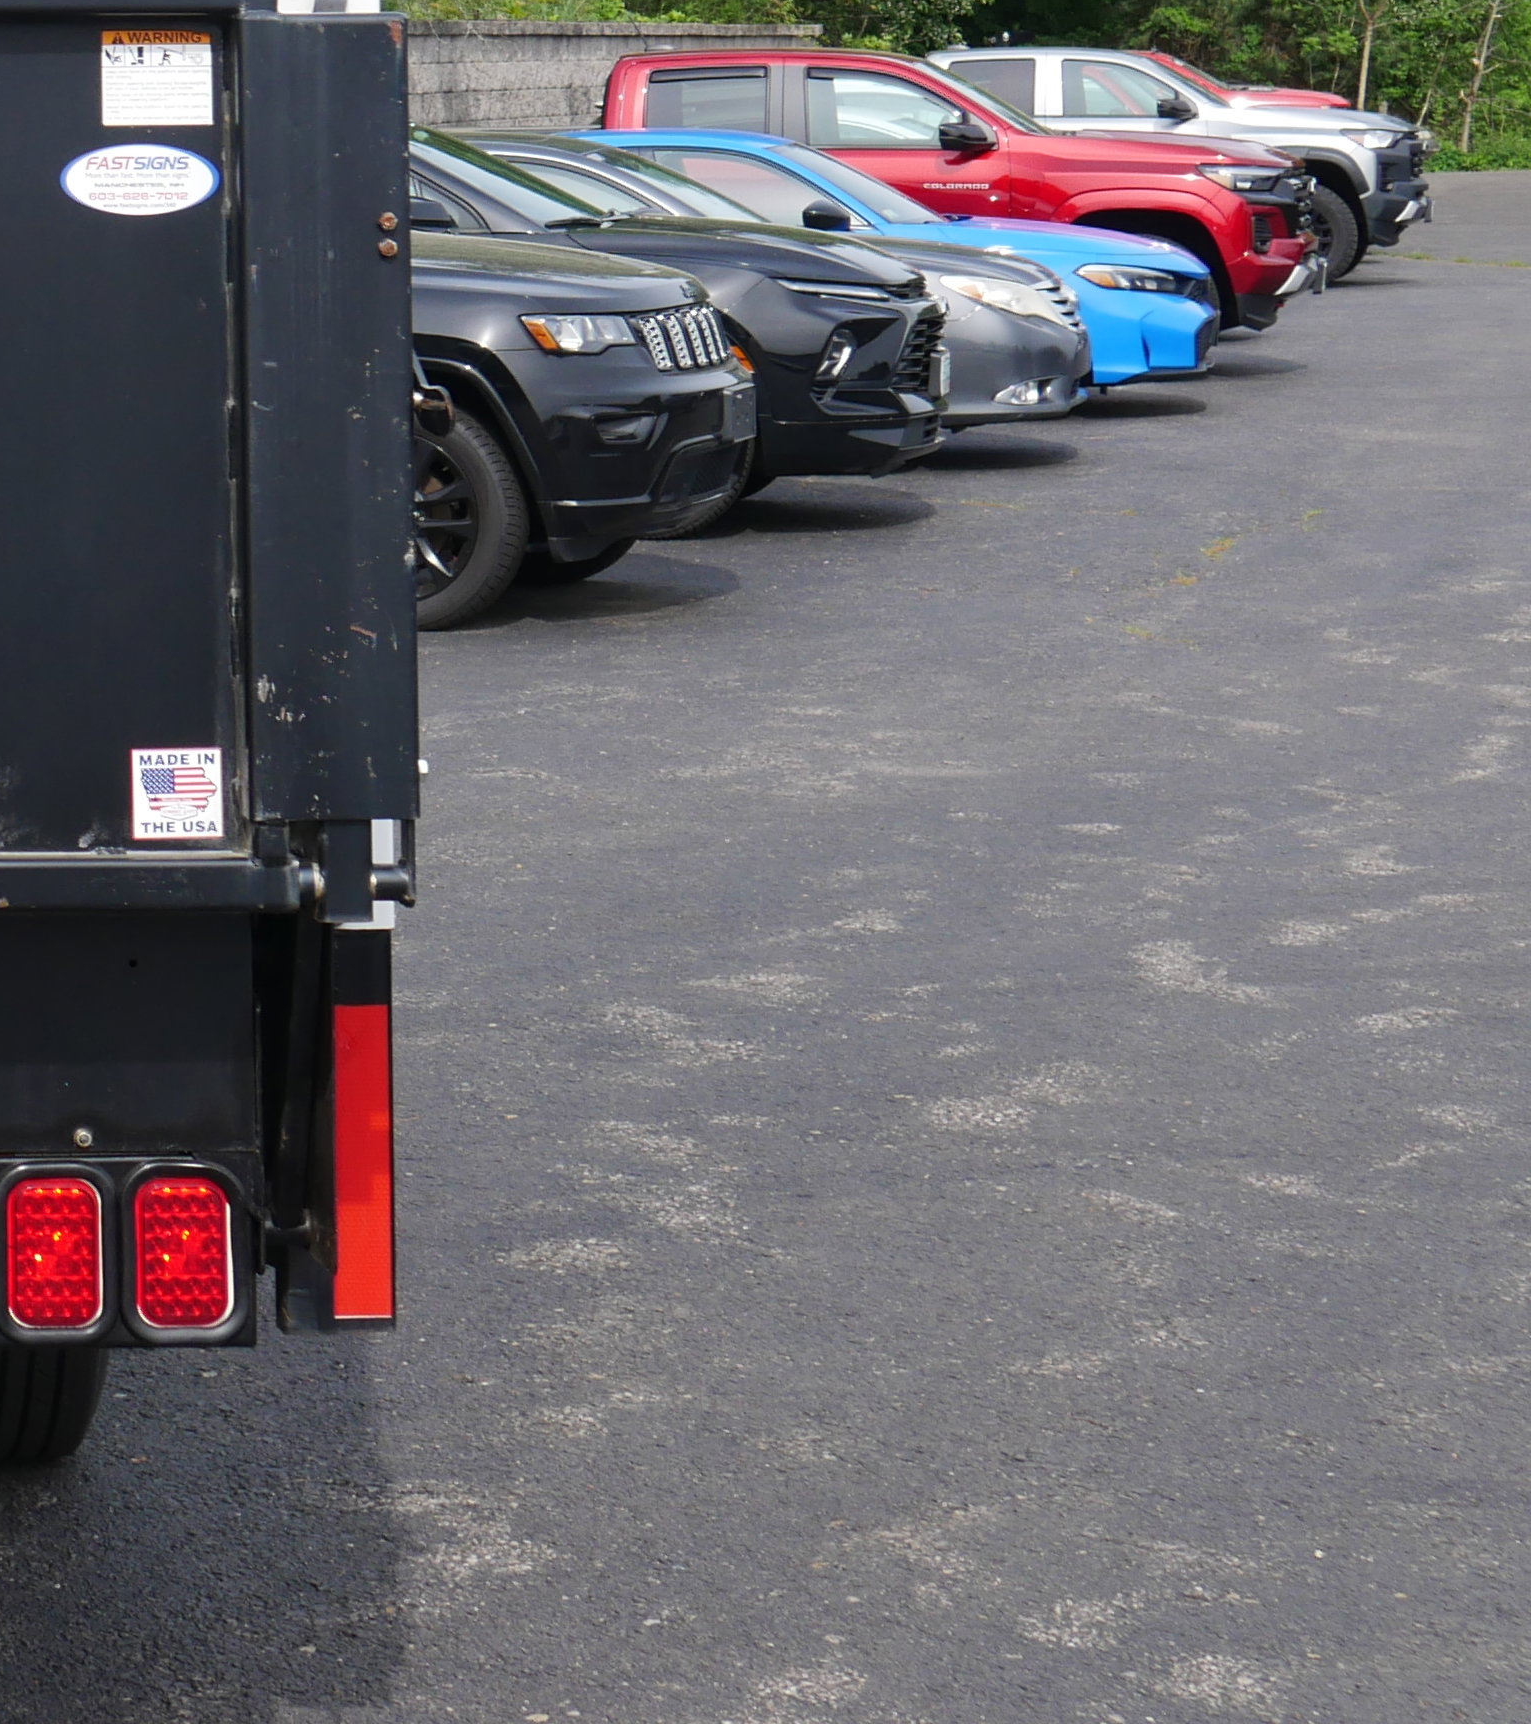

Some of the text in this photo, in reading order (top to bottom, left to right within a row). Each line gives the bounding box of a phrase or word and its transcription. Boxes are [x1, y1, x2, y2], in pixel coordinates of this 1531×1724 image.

[127, 31, 202, 44] WARNING
[85, 156, 190, 170] FASTSIGNS
[922, 182, 990, 190] COLORADO
[139, 753, 215, 766] MADE IN
[141, 820, 218, 834] THE USA
